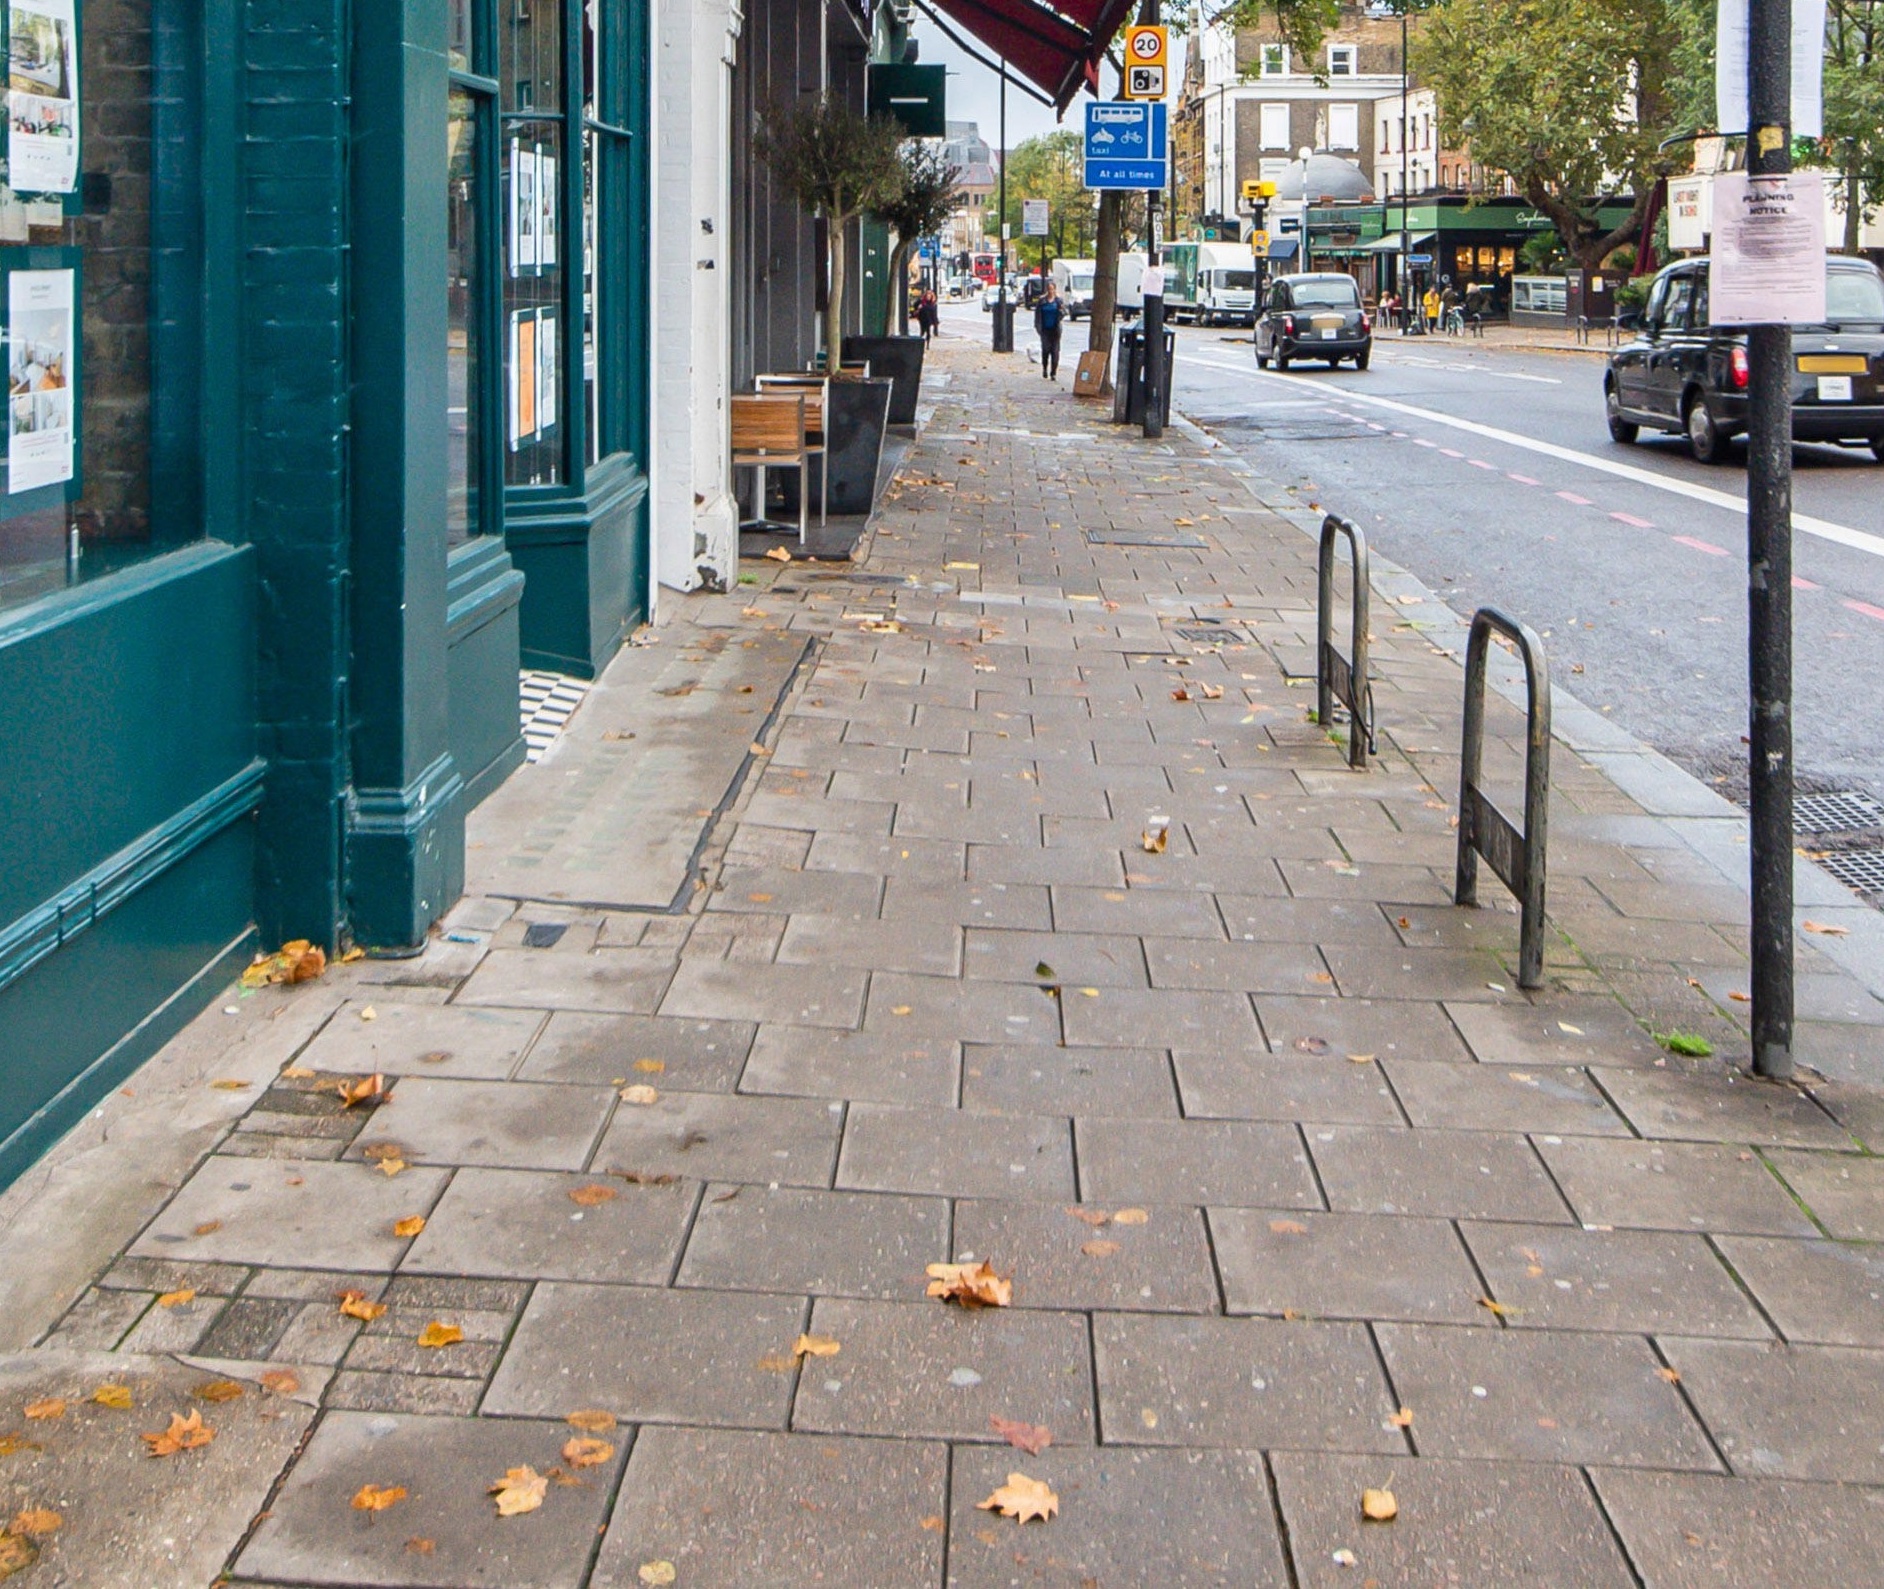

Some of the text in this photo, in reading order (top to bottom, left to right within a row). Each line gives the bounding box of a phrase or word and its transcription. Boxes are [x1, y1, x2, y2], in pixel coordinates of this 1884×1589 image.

[1136, 39, 1158, 52] 20
[1091, 146, 1110, 155] taxi
[1099, 169, 1155, 179] At all times
[1742, 193, 1794, 203] PLANNING
[1749, 206, 1787, 215] NOTICE
